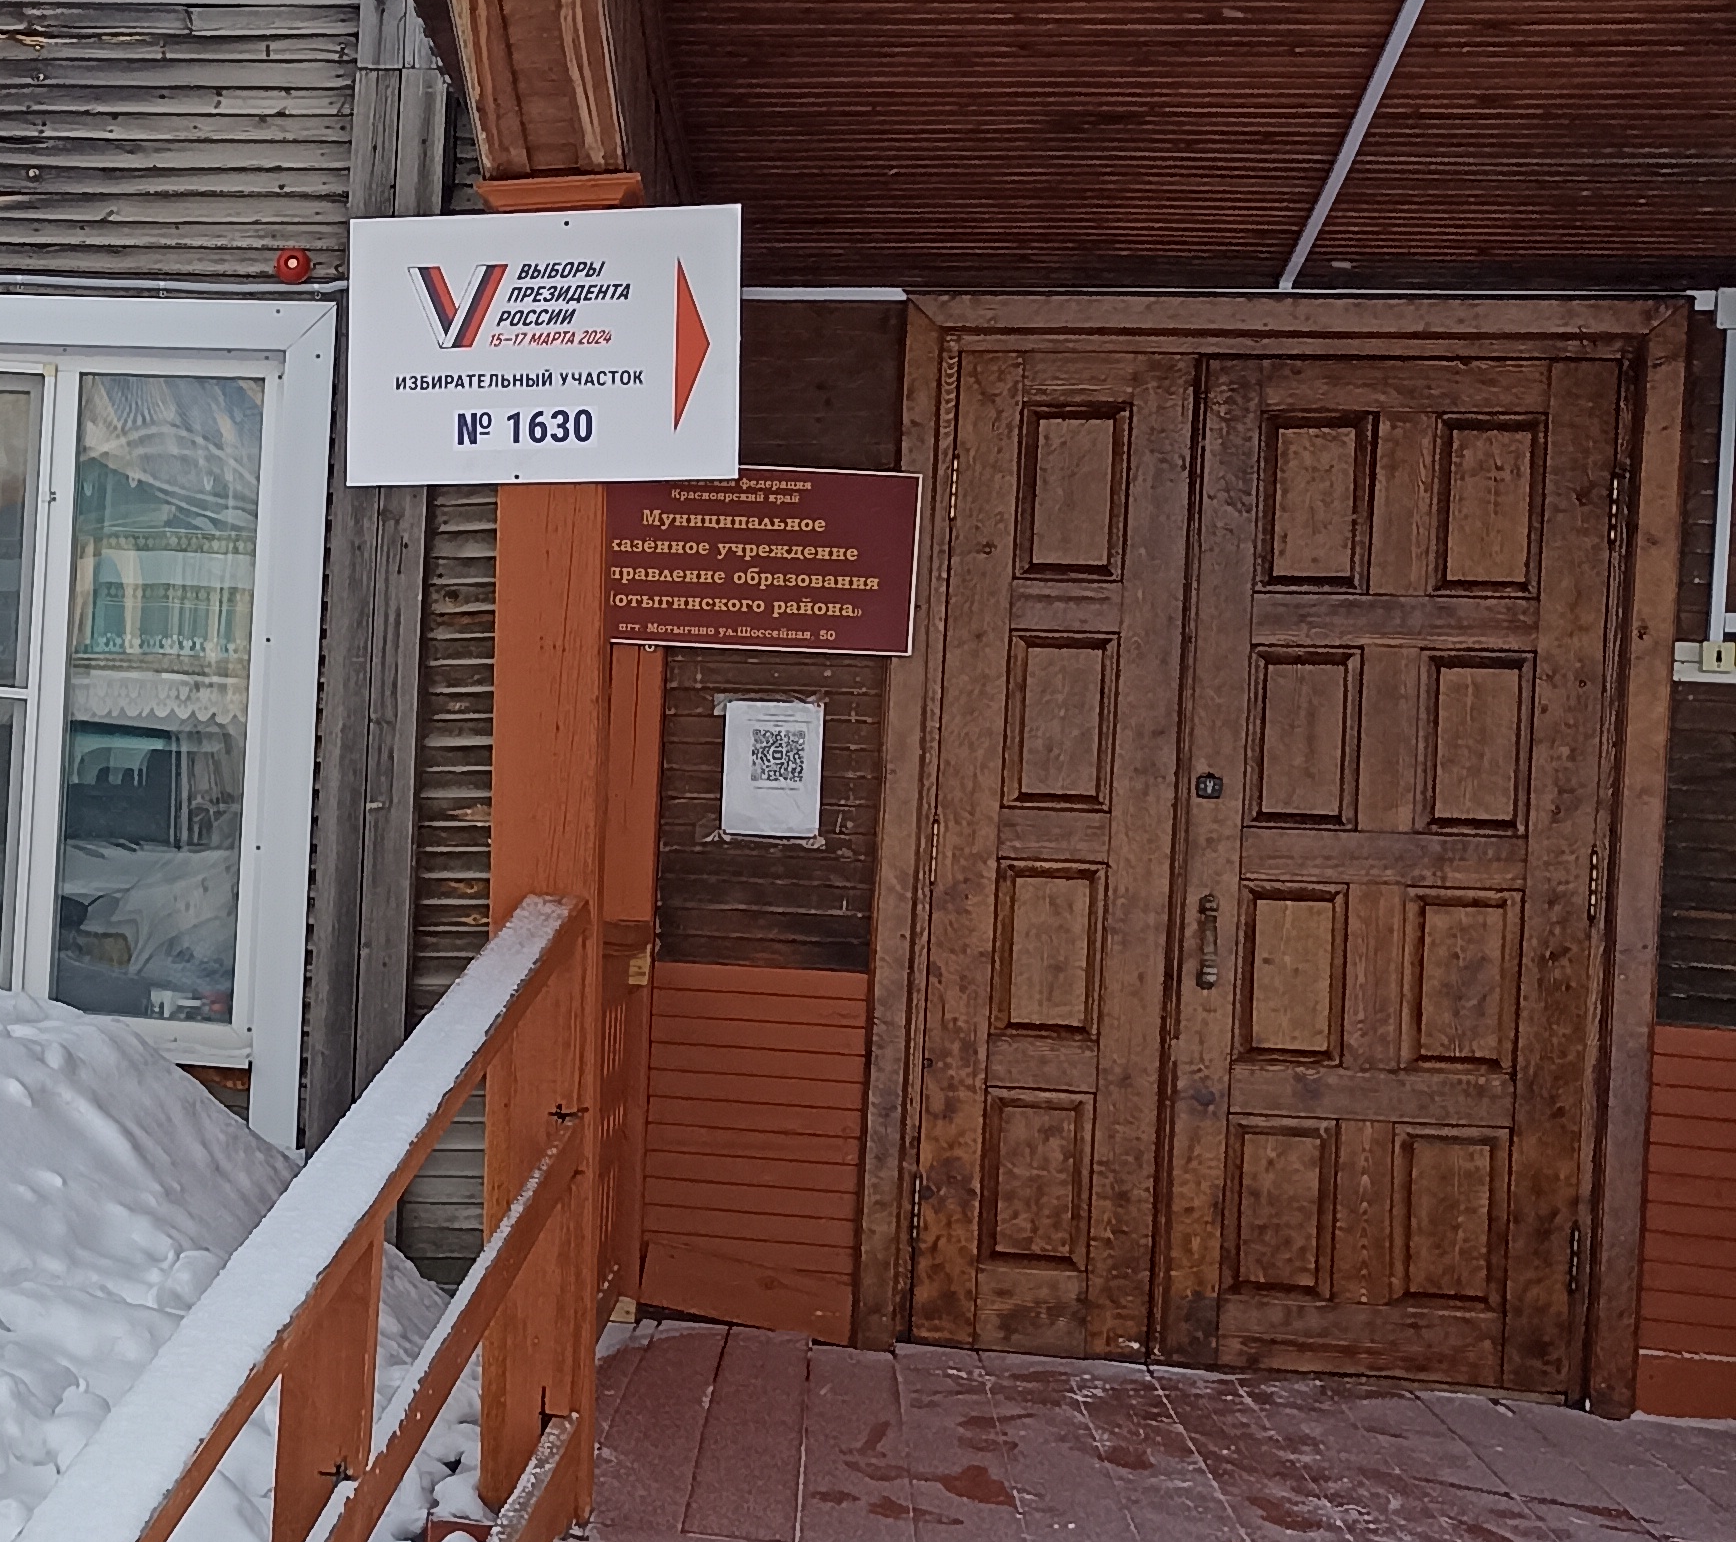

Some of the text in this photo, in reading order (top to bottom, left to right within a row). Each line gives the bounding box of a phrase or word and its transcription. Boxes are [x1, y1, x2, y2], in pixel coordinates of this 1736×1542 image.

[516, 261, 606, 281] ВЫБОРЫ
[506, 283, 631, 304] ПРЕЗИДЕНТА
[496, 309, 576, 327] РОССИИ
[528, 331, 577, 347] МАРТА
[578, 330, 612, 345] 2024
[395, 369, 644, 391] ИЗБИРАТЕЛЬНЫЙ УЧАСТОК
[457, 409, 593, 445] № 1630
[739, 478, 812, 490] федерация
[671, 489, 800, 505] Красноярский край
[642, 509, 826, 532] Муниципальное
[717, 542, 858, 561] учреждение
[610, 567, 880, 590] правление образования
[610, 590, 765, 613] отыгинского
[646, 622, 715, 636] Мотыгино
[819, 629, 836, 641] 50
